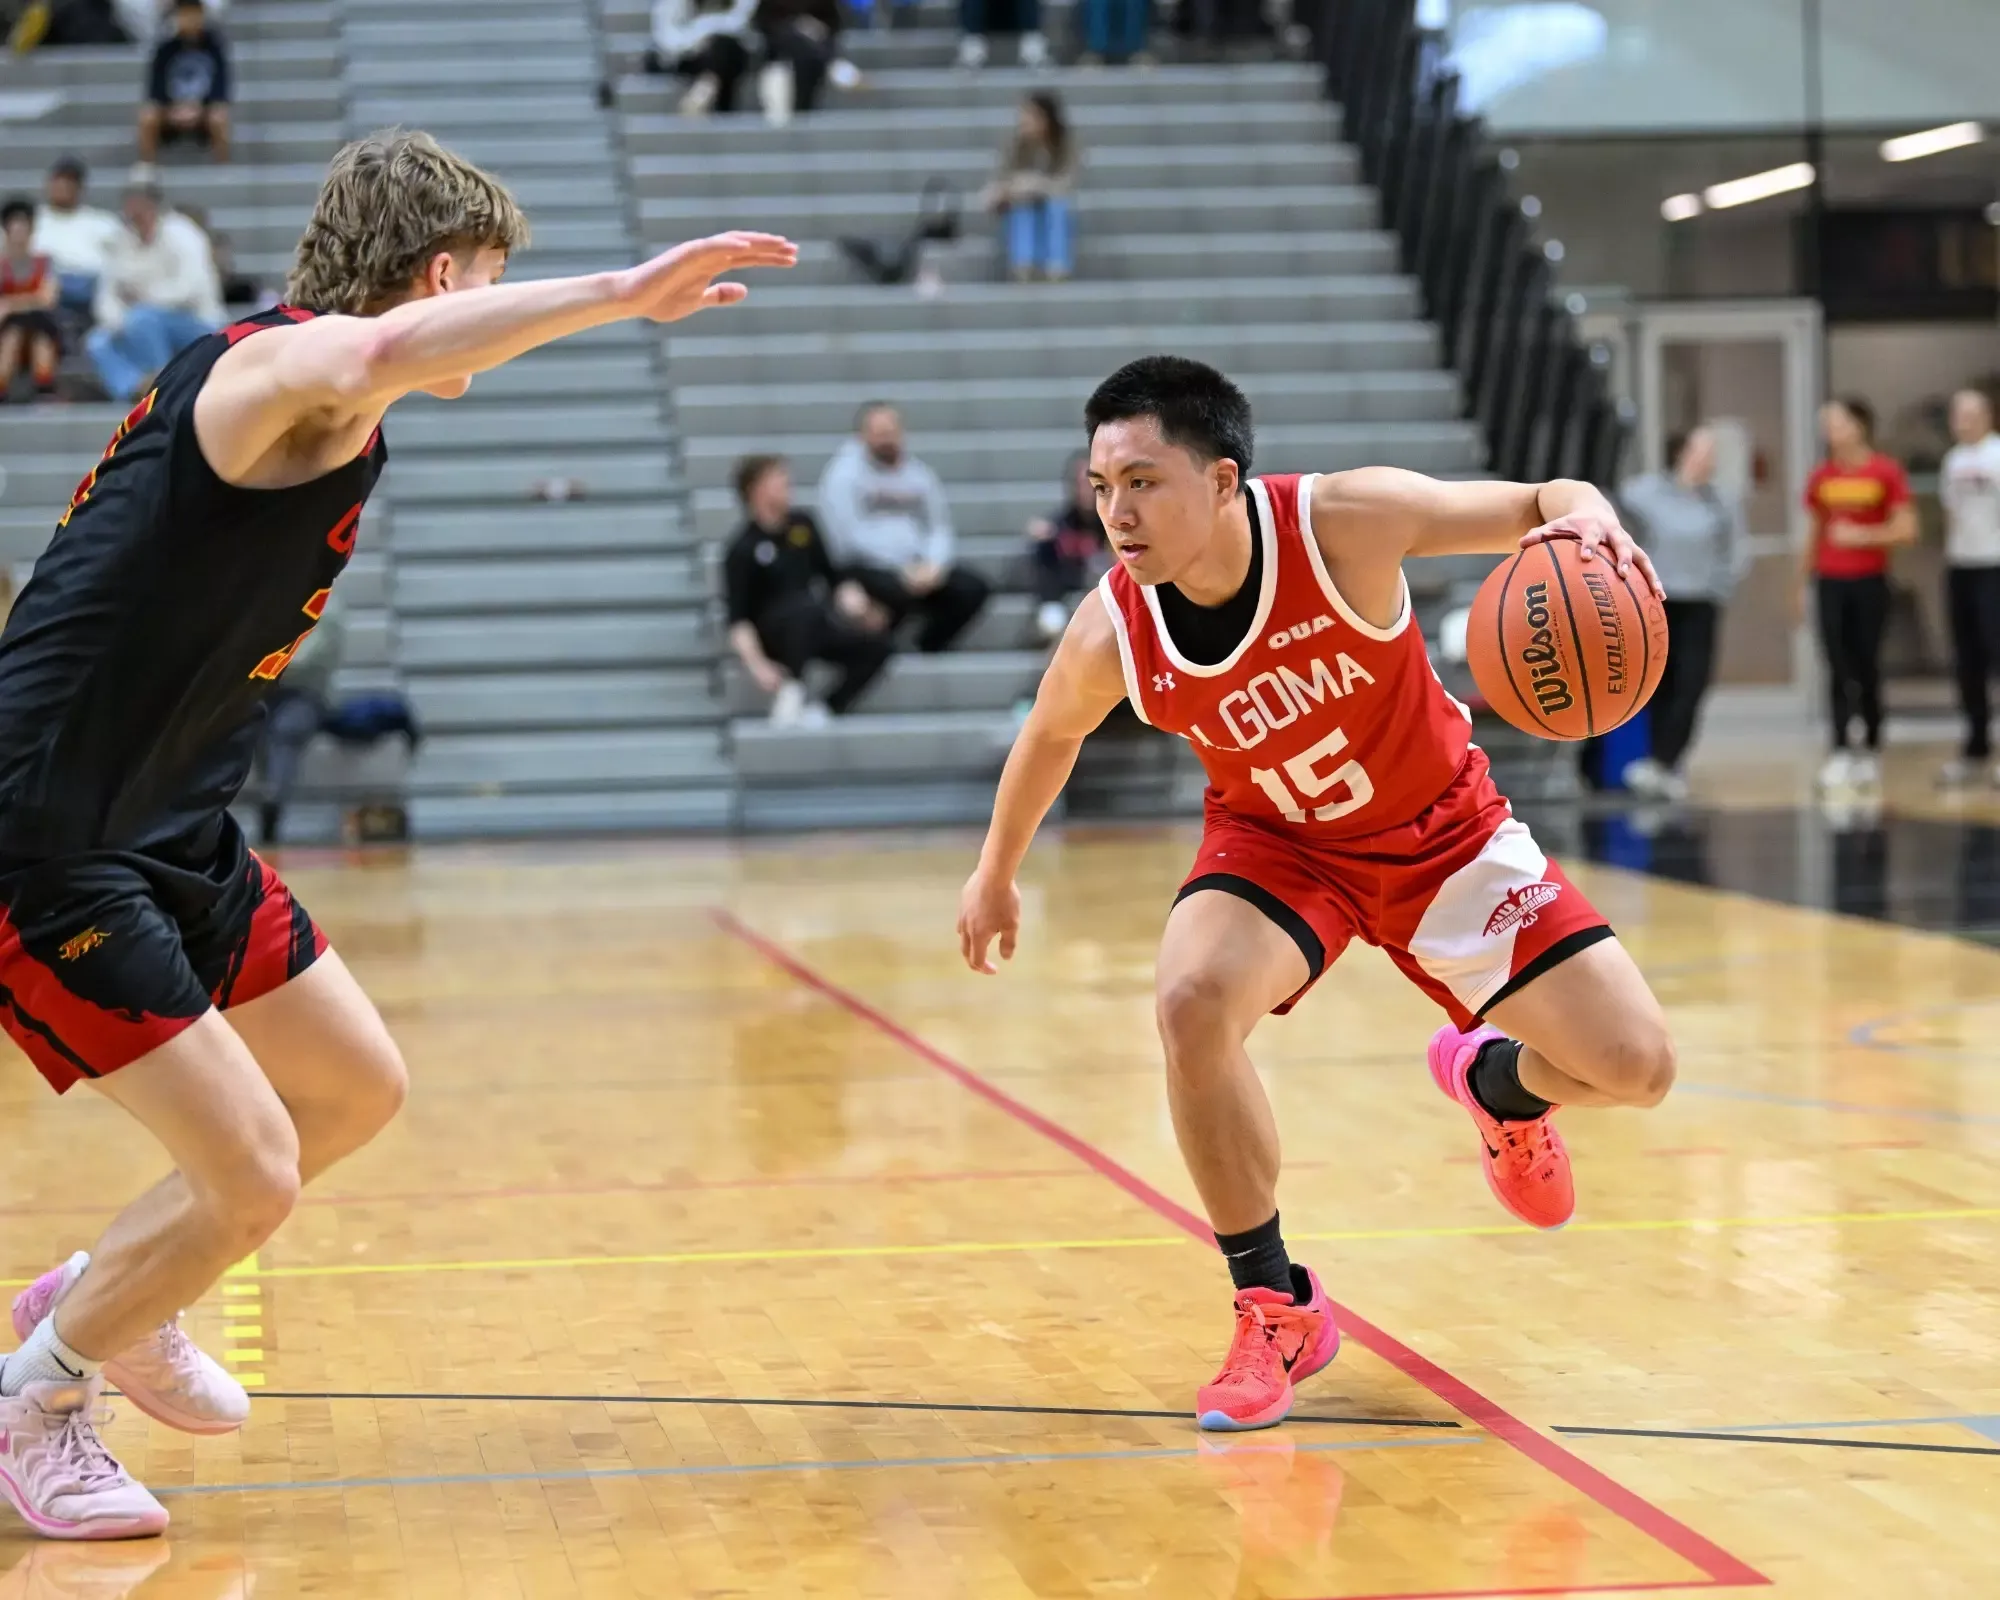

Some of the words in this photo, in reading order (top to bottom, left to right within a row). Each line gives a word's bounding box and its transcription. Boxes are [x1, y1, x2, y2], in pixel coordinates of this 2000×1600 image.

[1268, 614, 1336, 650] OUA
[1522, 580, 1574, 716] Wilson
[1582, 573, 1624, 695] EVOLUTION
[1250, 727, 1375, 823] 15
[1489, 887, 1556, 936] THUNDERBIRDS
